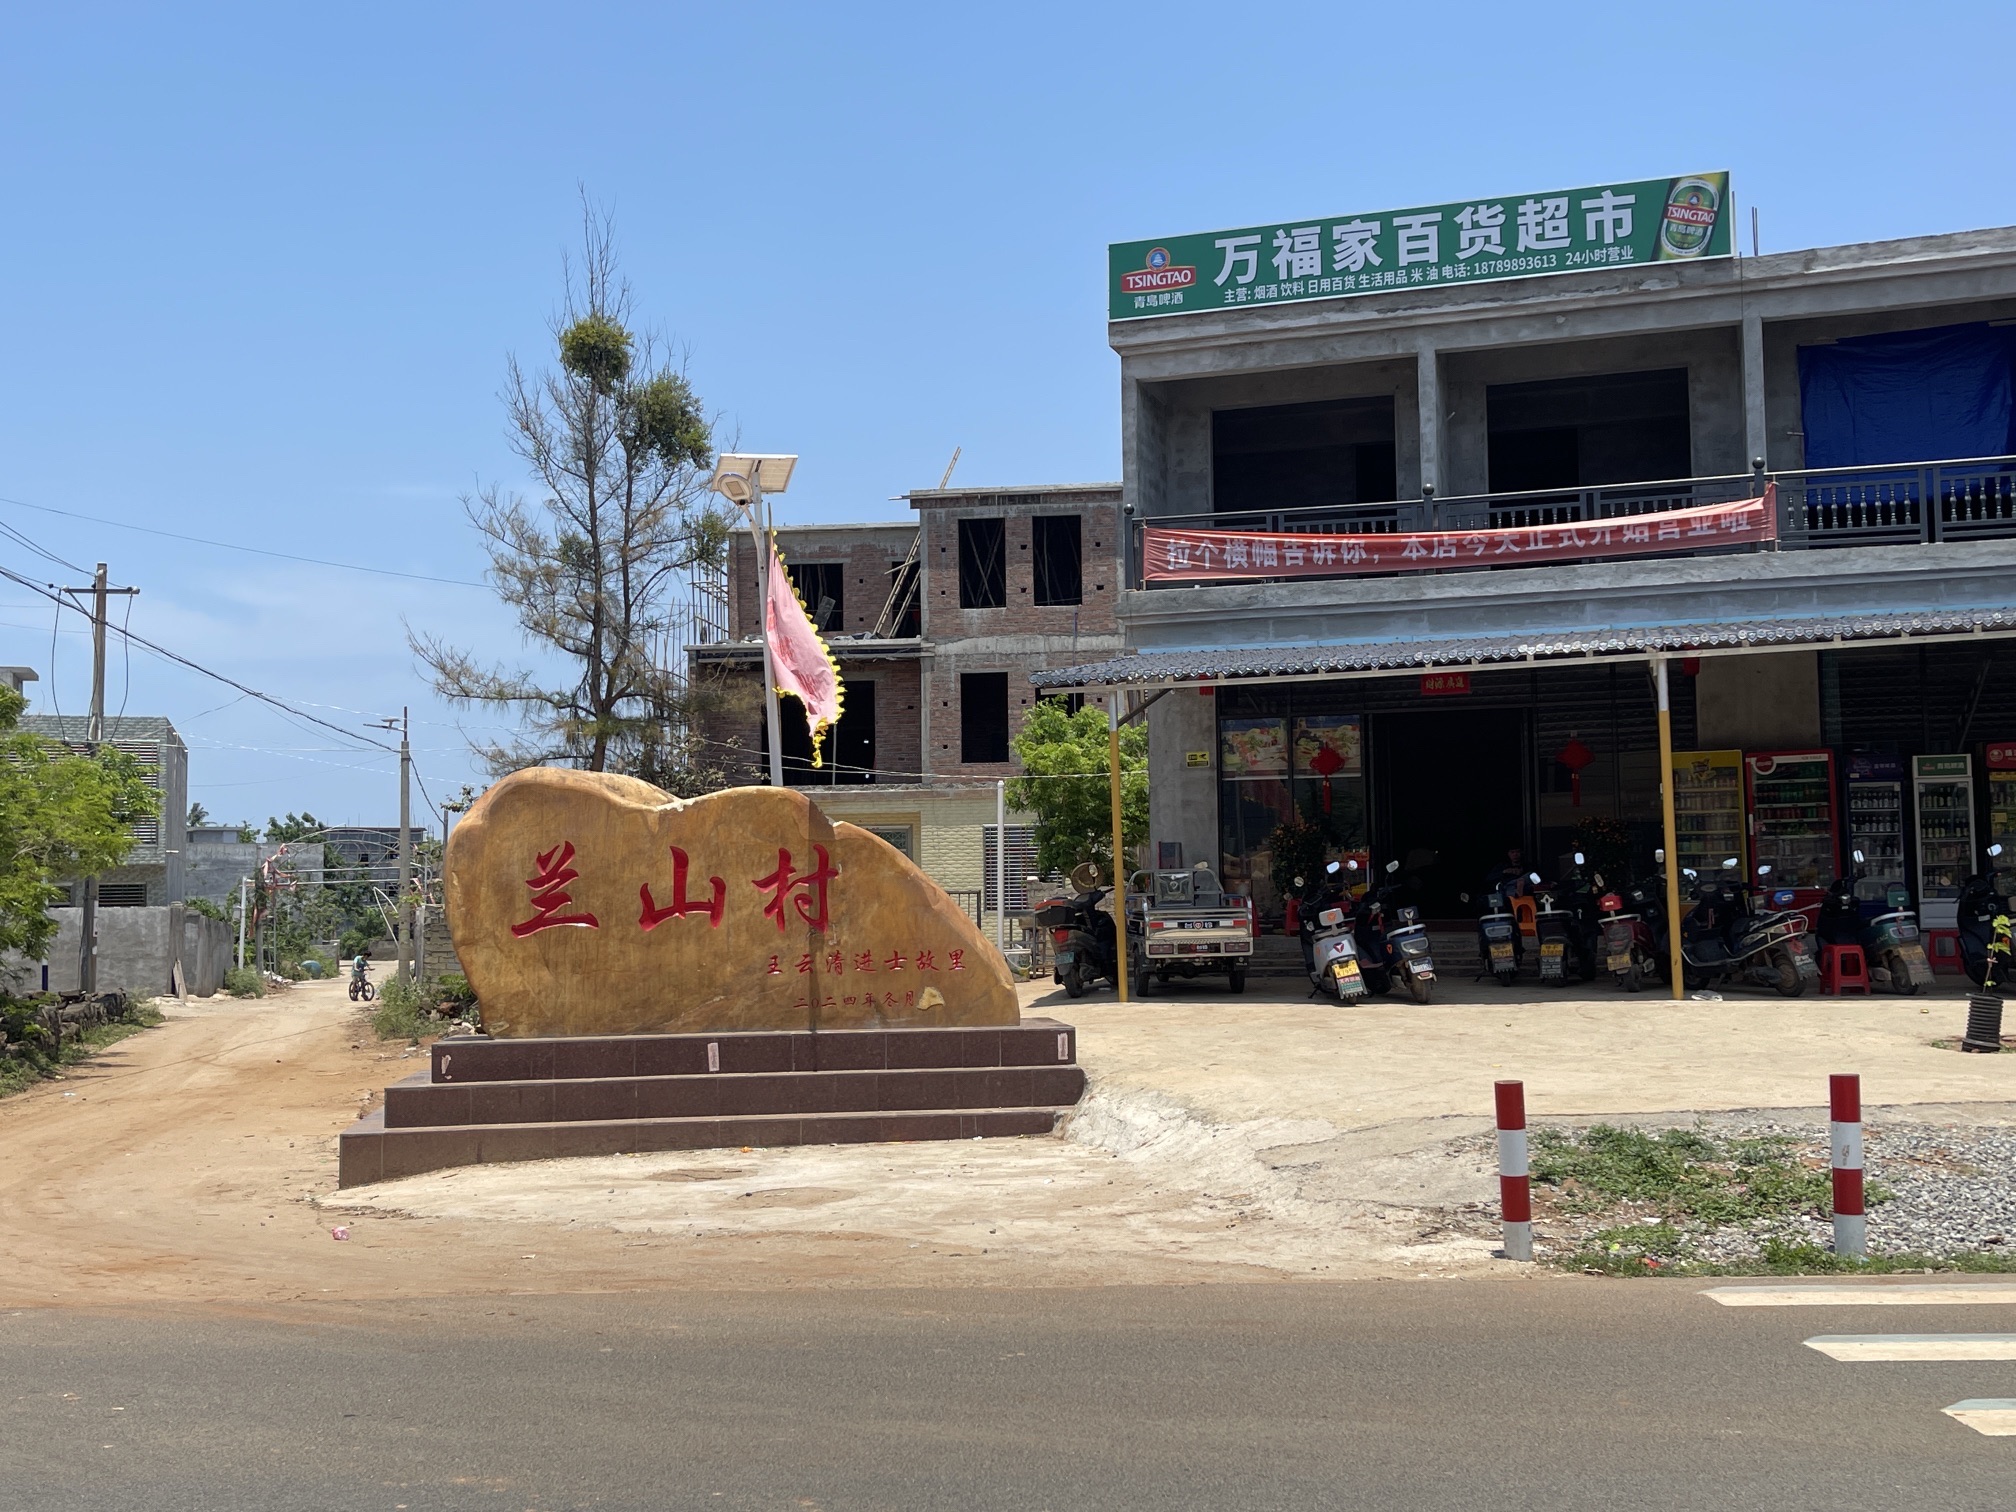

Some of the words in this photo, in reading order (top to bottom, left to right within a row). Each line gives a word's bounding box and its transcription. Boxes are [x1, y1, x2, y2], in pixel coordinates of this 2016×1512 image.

[1666, 207, 1715, 223] TSINGTAO
[1213, 189, 1637, 287] 万福家百货超市
[1126, 269, 1191, 288] TSINGTAO
[1308, 275, 1356, 294] 日用百货
[1358, 269, 1408, 289] 生活用品
[1473, 254, 1557, 276] 18789893613
[1565, 245, 1634, 265] 24小时营业
[511, 841, 839, 938] 兰山村
[766, 949, 967, 976] 王云清进士故里
